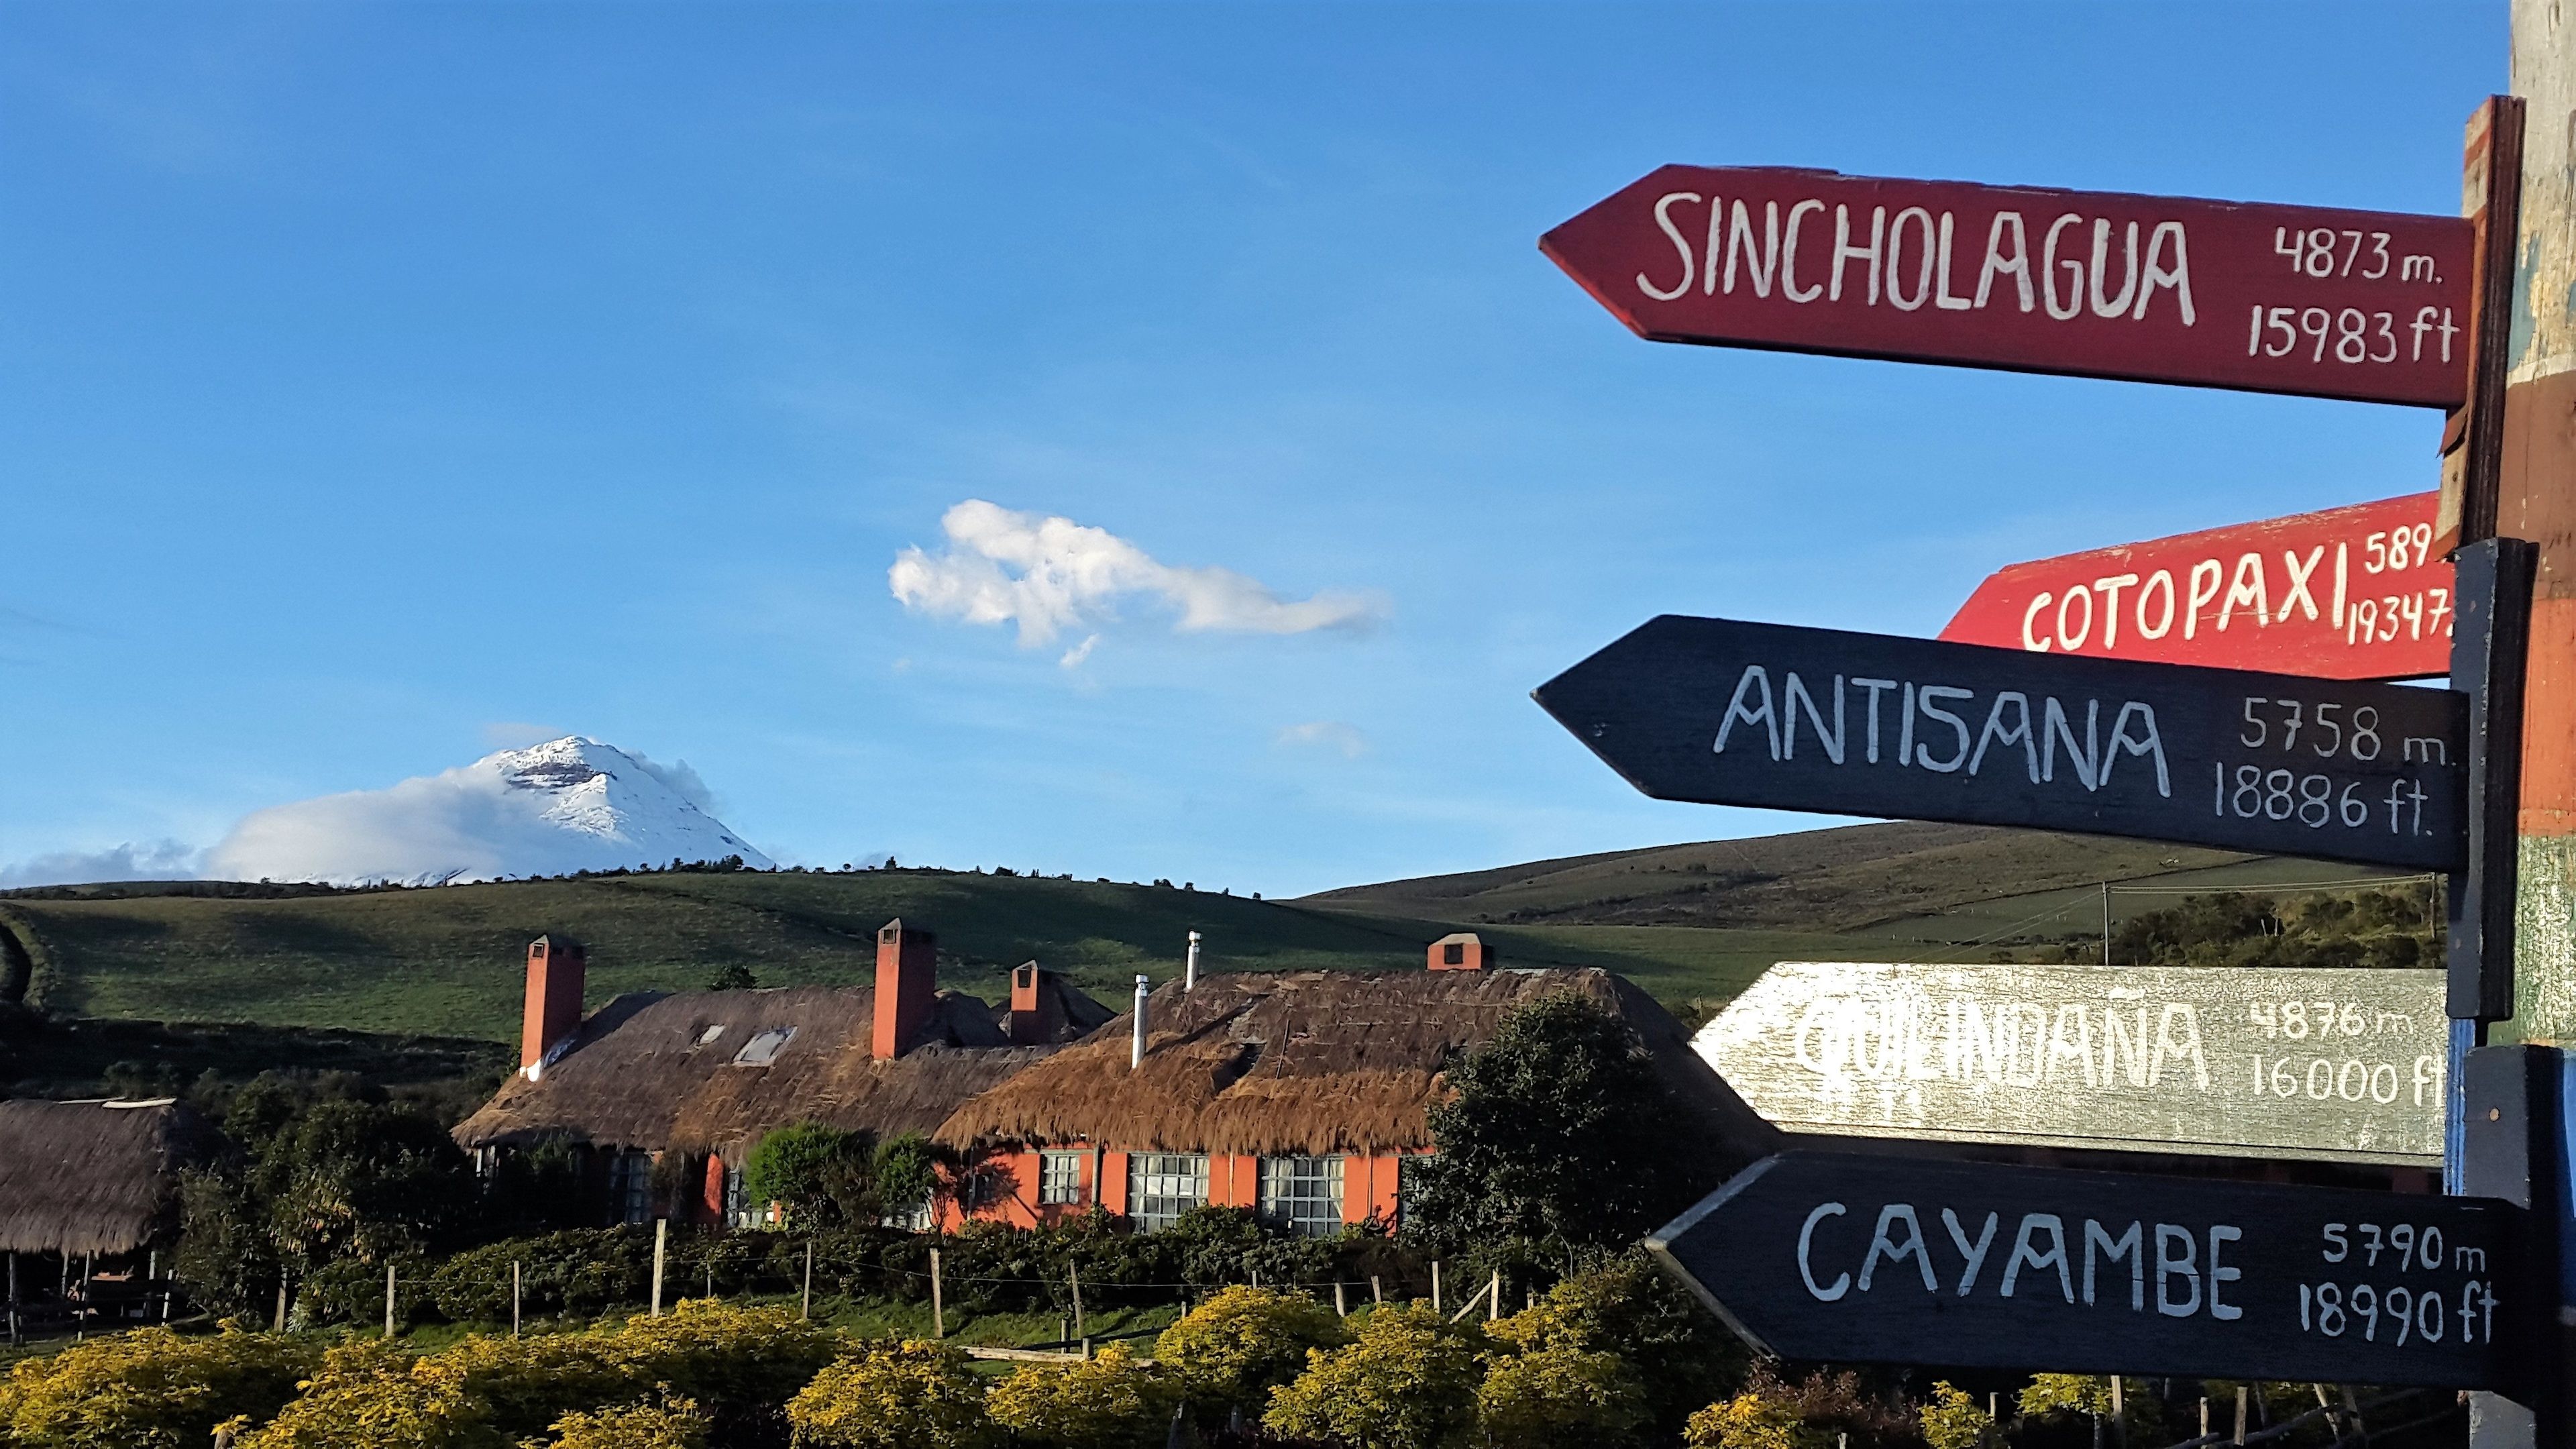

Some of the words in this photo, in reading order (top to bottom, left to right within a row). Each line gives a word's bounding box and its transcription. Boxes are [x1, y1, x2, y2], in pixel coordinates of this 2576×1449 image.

[1635, 192, 2196, 327] SINCHOLAGUA
[2274, 226, 2390, 278] 4873
[2248, 305, 2398, 364] 15983
[2408, 306, 2460, 364] ft
[2365, 523, 2450, 574] 589
[2023, 542, 2348, 653] COTOPAXI
[1713, 665, 2171, 798] ANTISANA
[2241, 696, 2381, 761] 5758
[2216, 760, 2368, 828] 18886
[2383, 777, 2433, 837] ft.
[1794, 987, 2209, 1092] QUILINDAÑA
[2249, 1001, 2366, 1040] 4876
[2376, 1013, 2414, 1035] m
[2253, 1054, 2398, 1104] 16000
[2411, 1055, 2449, 1108] ft
[1797, 1202, 2243, 1320] CAYAMBE
[2322, 1222, 2443, 1273] 5790
[2455, 1246, 2485, 1273] m
[2299, 1281, 2444, 1347] 18990
[2456, 1279, 2502, 1344] ft
